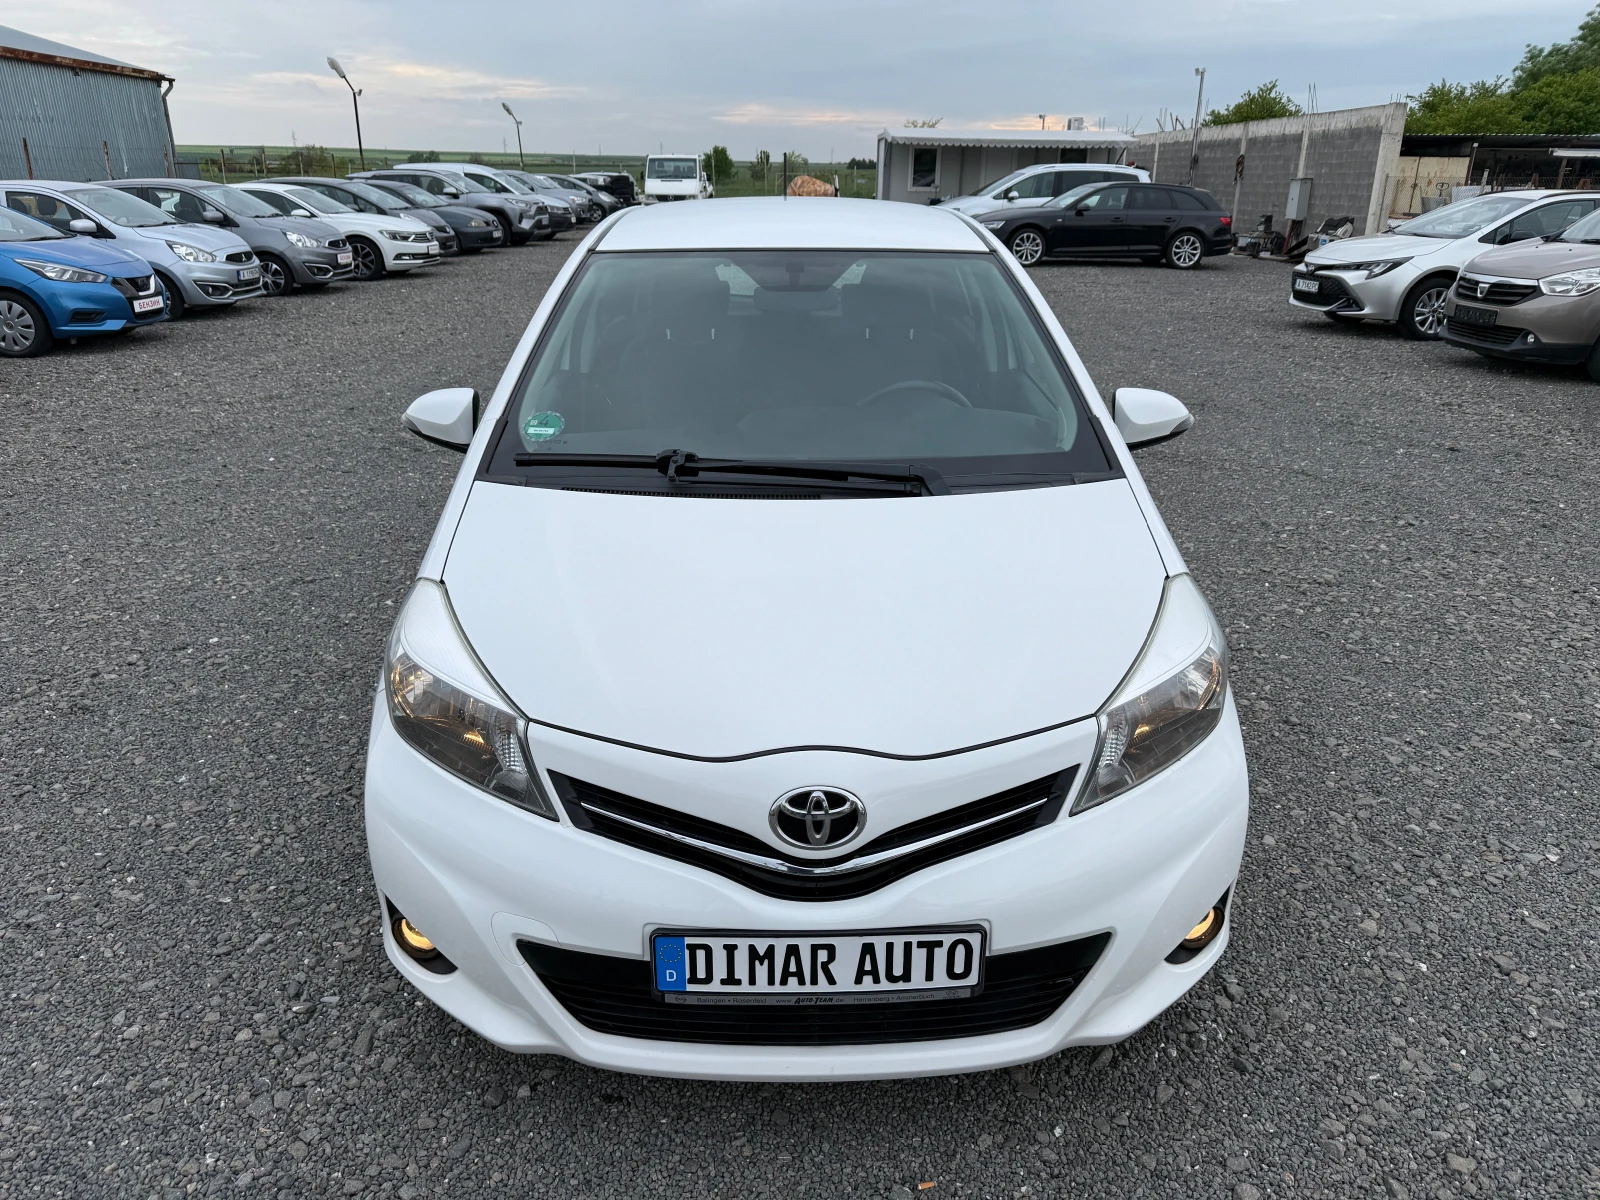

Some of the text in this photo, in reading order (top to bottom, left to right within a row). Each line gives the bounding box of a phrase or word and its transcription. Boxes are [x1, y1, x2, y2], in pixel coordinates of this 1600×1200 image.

[138, 299, 160, 309] БЕНЗИН
[539, 415, 549, 426] 4
[686, 938, 974, 986] DIMAR AUTO
[666, 969, 677, 982] D
[896, 993, 935, 1001] Ammerbuch
